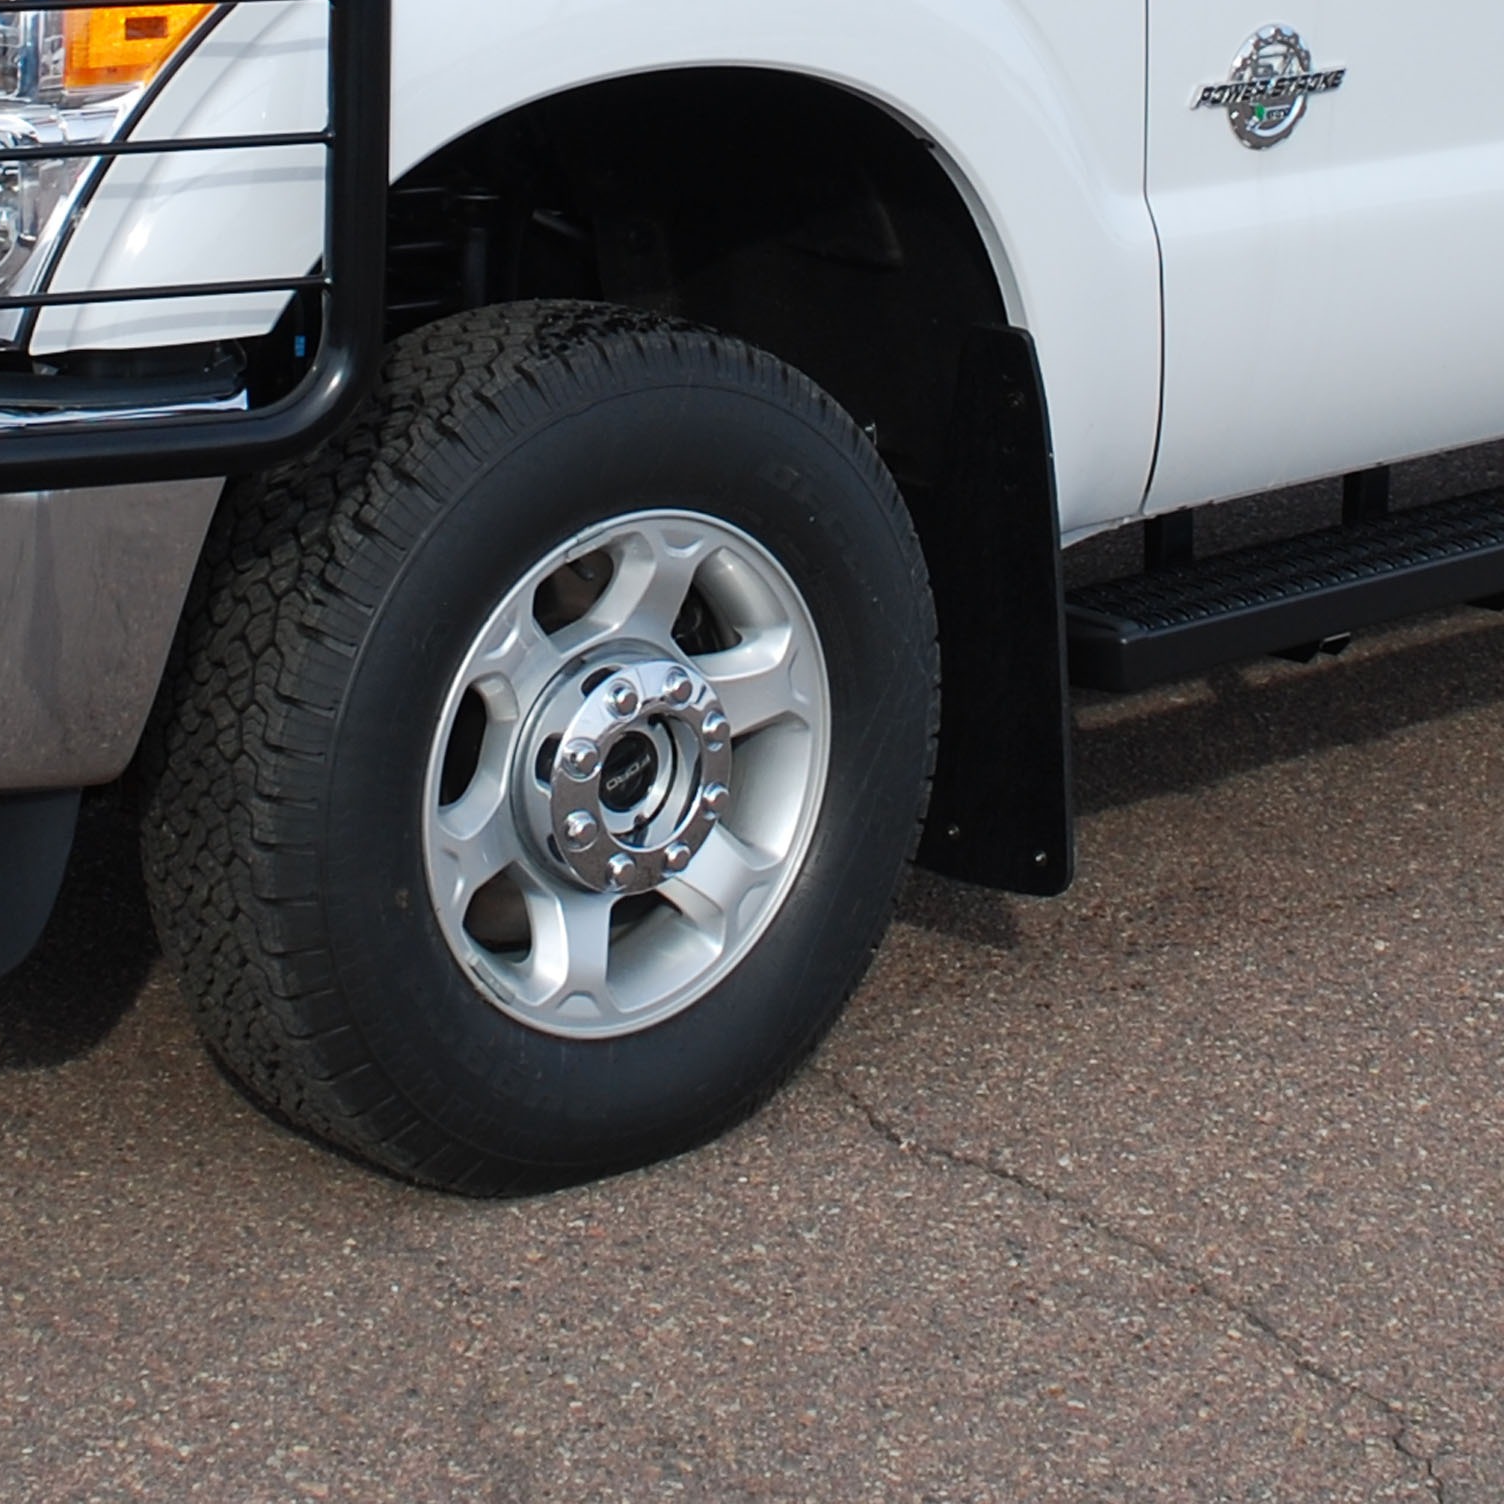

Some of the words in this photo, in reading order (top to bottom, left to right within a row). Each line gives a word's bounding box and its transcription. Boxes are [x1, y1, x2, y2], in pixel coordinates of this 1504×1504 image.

[1198, 79, 1270, 105] POWER
[1271, 68, 1346, 97] STROKE
[606, 753, 651, 791] FORD
